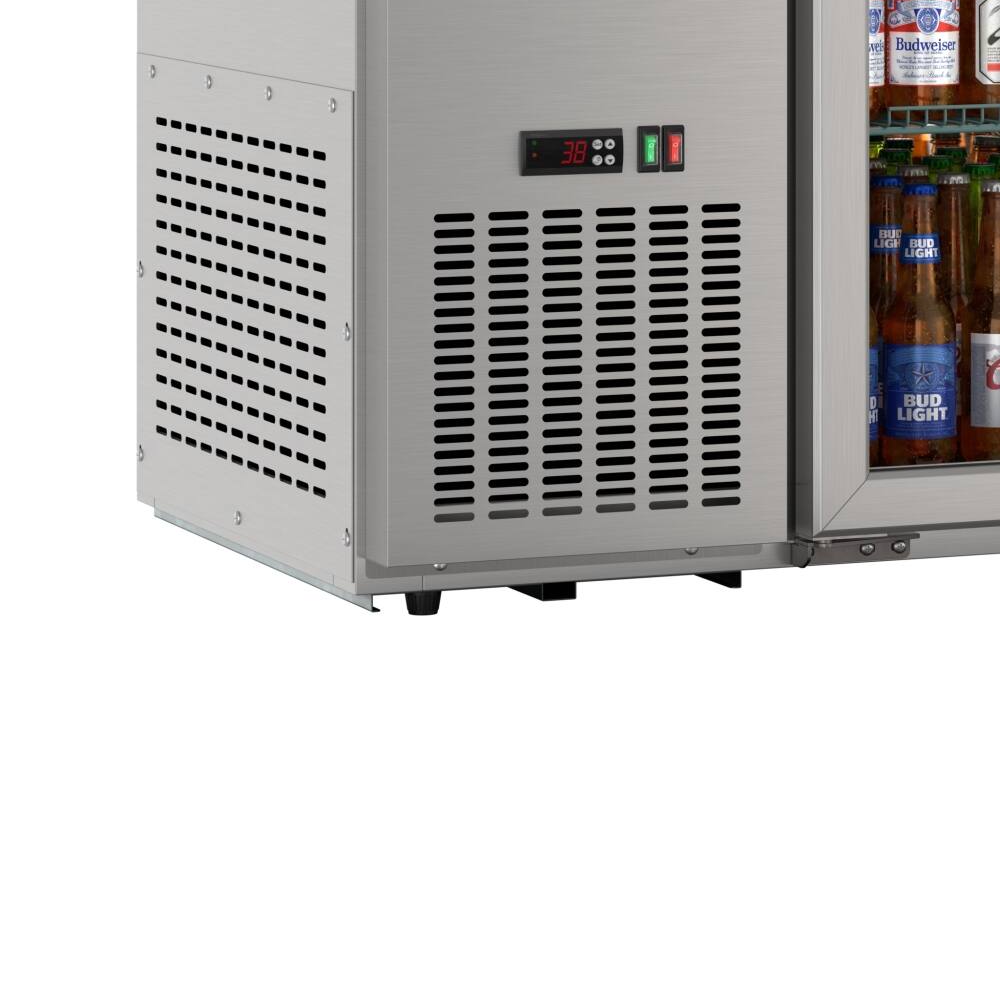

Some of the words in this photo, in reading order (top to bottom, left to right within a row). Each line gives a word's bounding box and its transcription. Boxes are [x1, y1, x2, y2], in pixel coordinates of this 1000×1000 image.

[895, 37, 956, 51] Budweiser
[560, 139, 588, 165] 38
[909, 238, 934, 249] BUD
[904, 248, 938, 259] LIGHT
[903, 393, 942, 407] BUD
[897, 407, 948, 422] LIGHT
